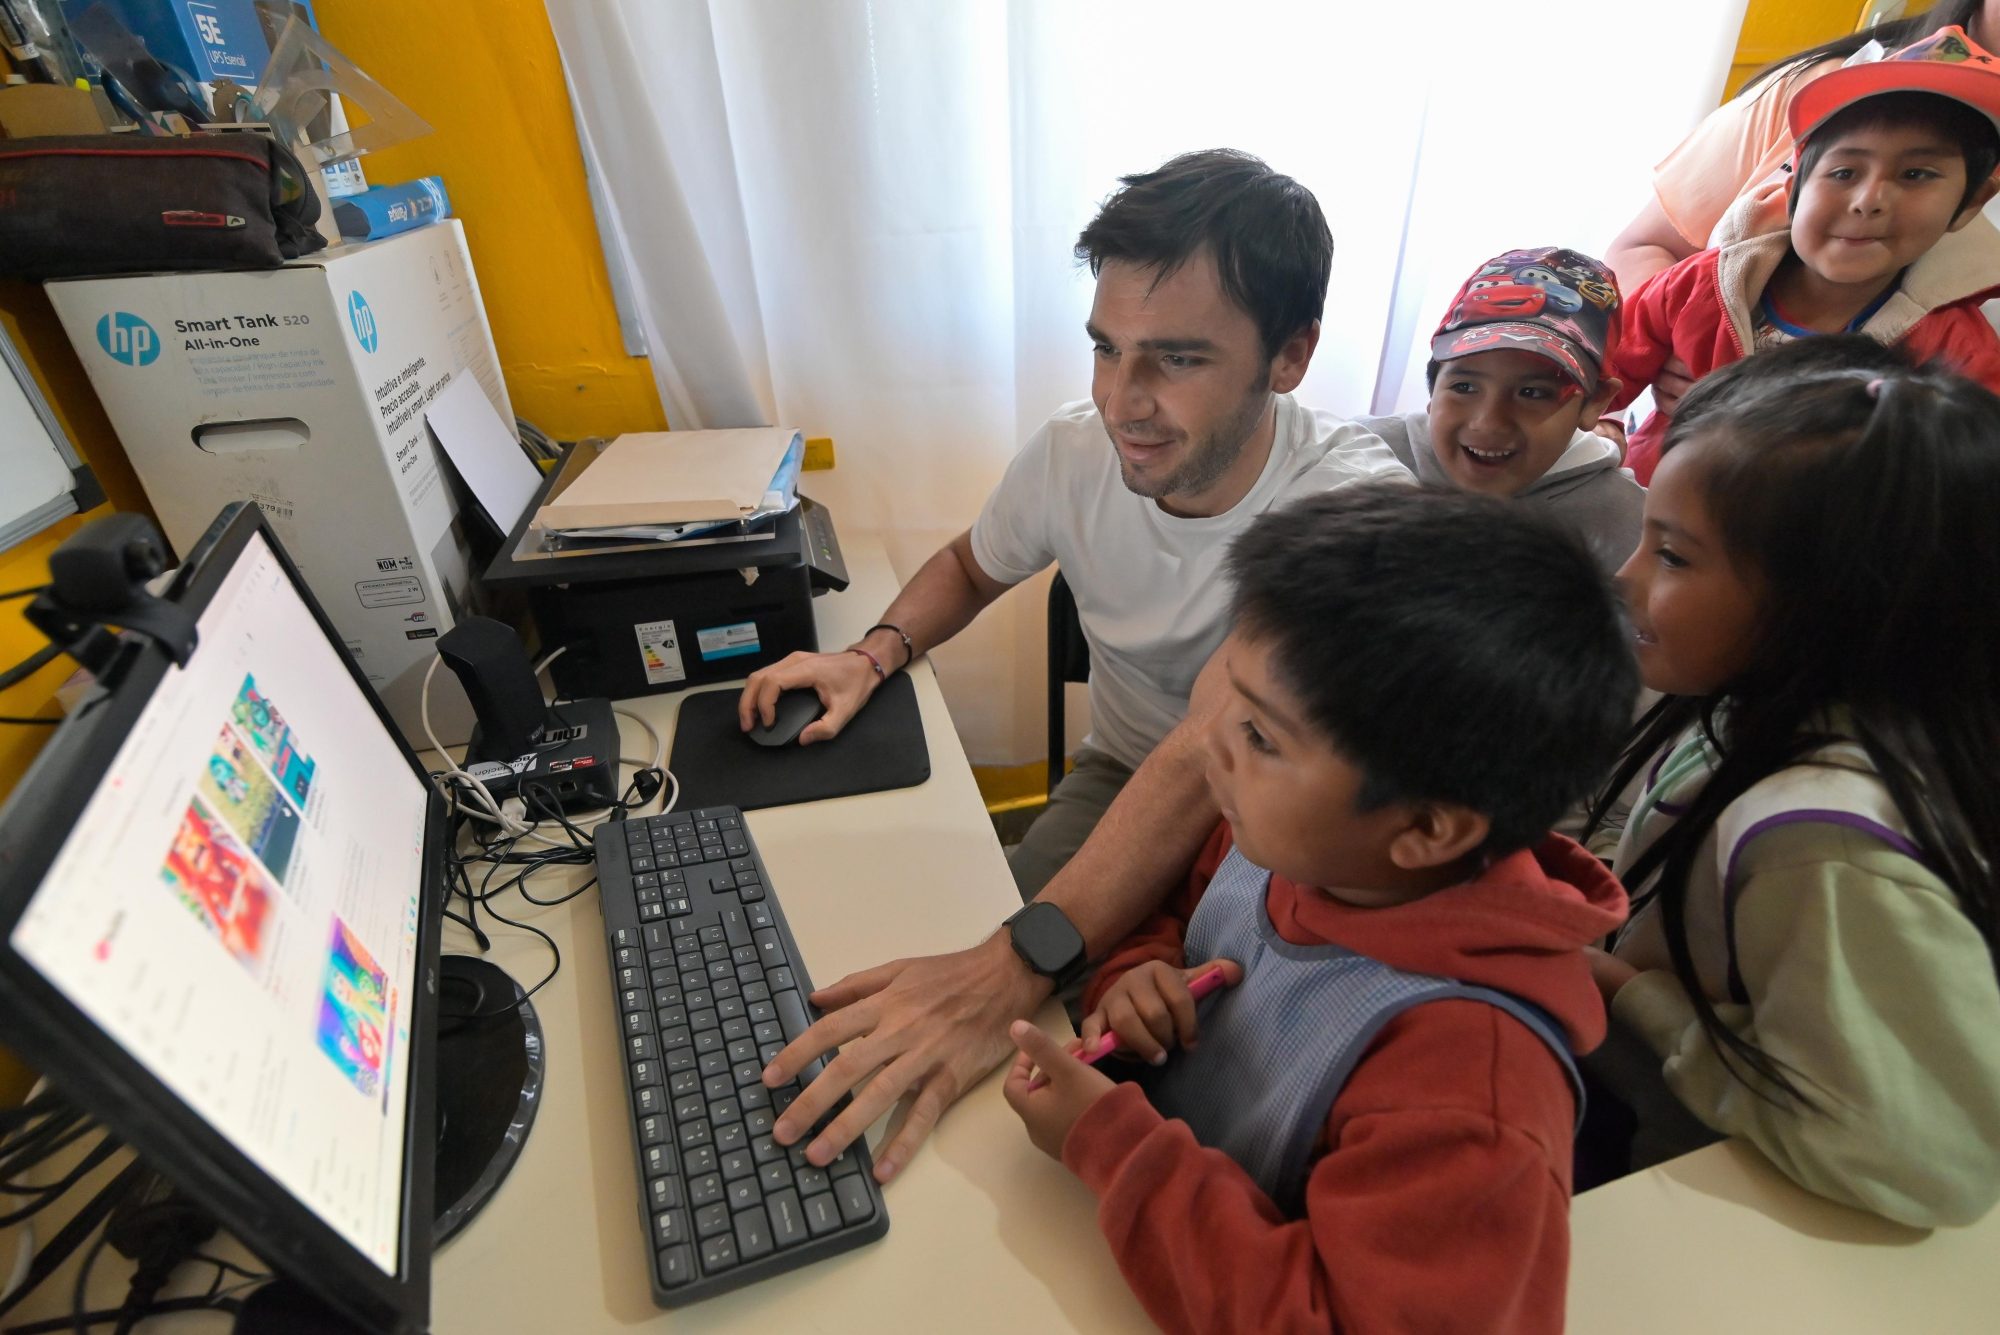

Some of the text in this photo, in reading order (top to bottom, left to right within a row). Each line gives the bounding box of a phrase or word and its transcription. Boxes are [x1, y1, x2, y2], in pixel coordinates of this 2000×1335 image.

[195, 14, 226, 46] 5E
[208, 50, 225, 64] UPS
[174, 314, 310, 333] Smart Tank 520
[350, 290, 376, 354] hp
[105, 312, 152, 366] hp
[185, 336, 260, 351] All-in-One
[374, 376, 399, 402] Intuitiva
[402, 356, 427, 382] inteligente.
[380, 380, 422, 418] Precio accesible.
[386, 406, 412, 436] Intuitively
[411, 395, 426, 414] smart.
[424, 385, 436, 402] Light
[396, 443, 410, 462] Smart
[408, 434, 418, 450] Tank
[376, 560, 398, 570] NOM
